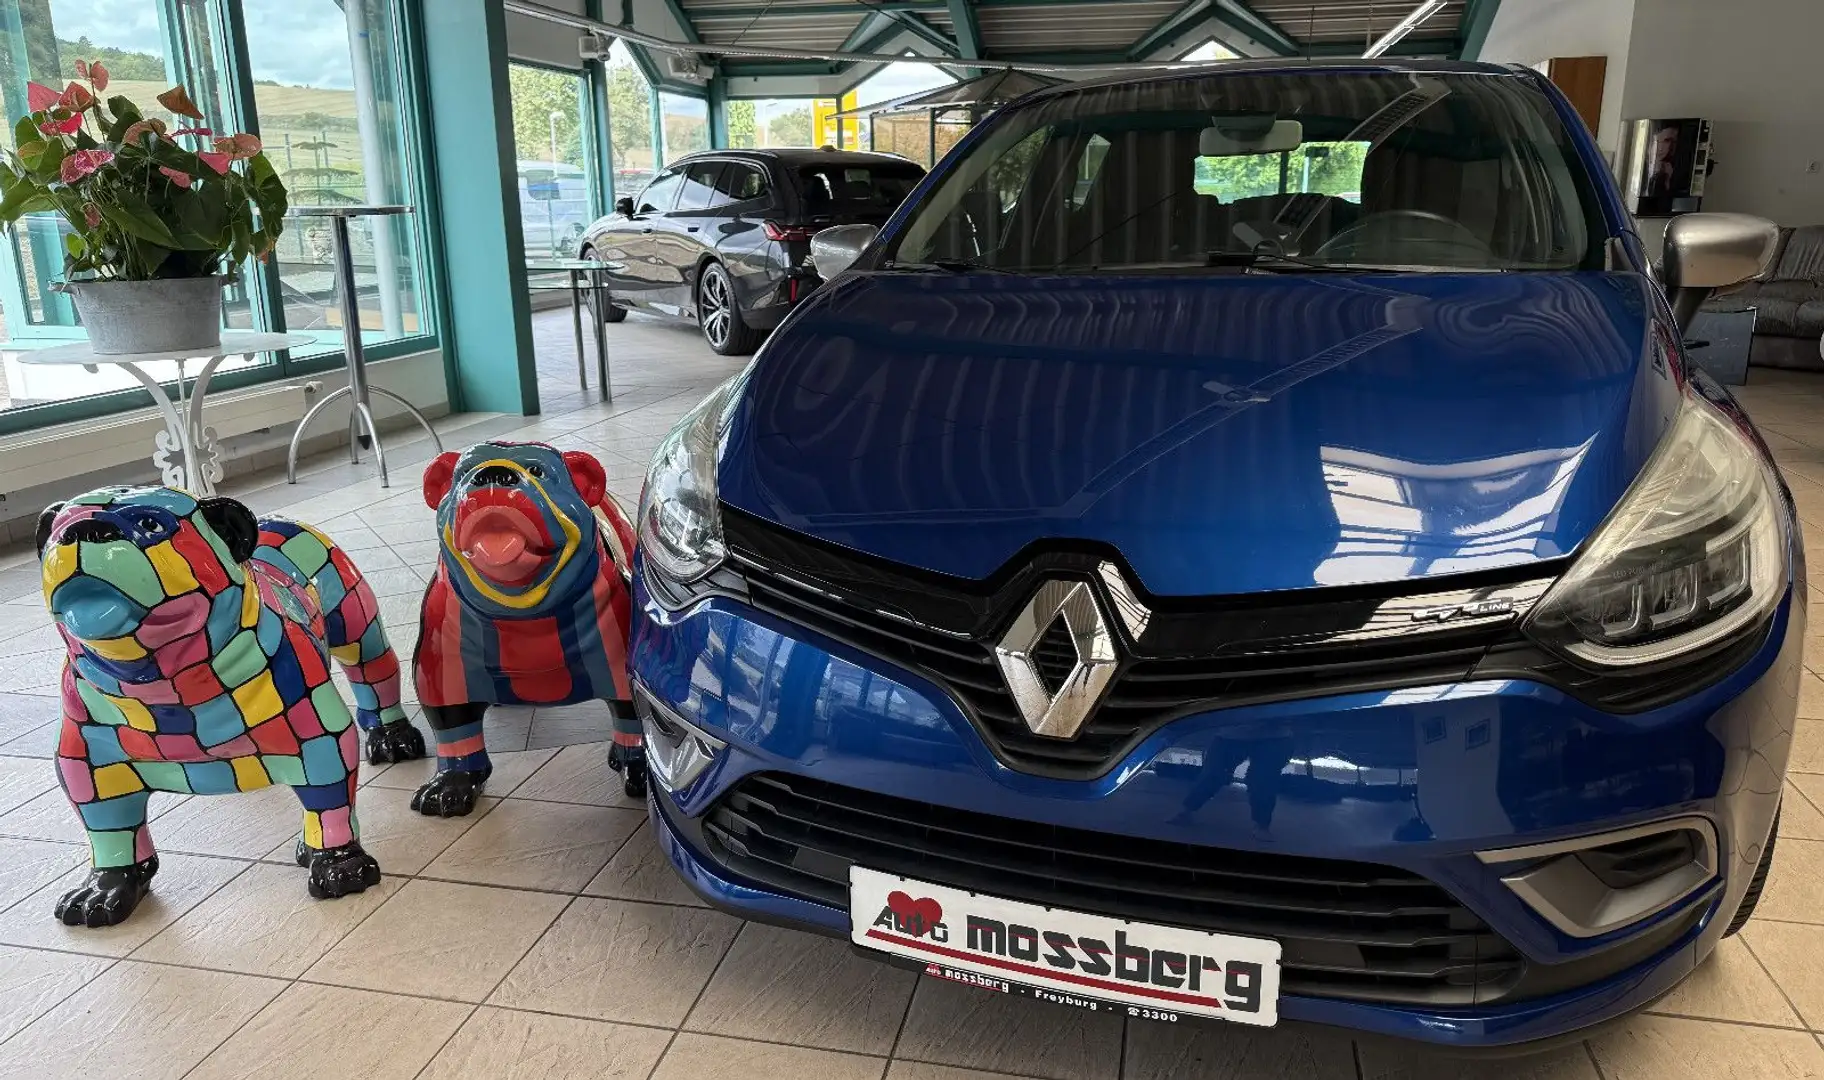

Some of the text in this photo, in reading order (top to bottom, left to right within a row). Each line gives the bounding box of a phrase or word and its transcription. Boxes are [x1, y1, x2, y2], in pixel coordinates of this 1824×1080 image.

[1480, 602, 1511, 613] LINE
[966, 914, 1263, 1013] mossberg
[945, 968, 1009, 994] mossberg
[1035, 989, 1097, 1010] Freyburg
[1142, 1009, 1178, 1022] 3300
